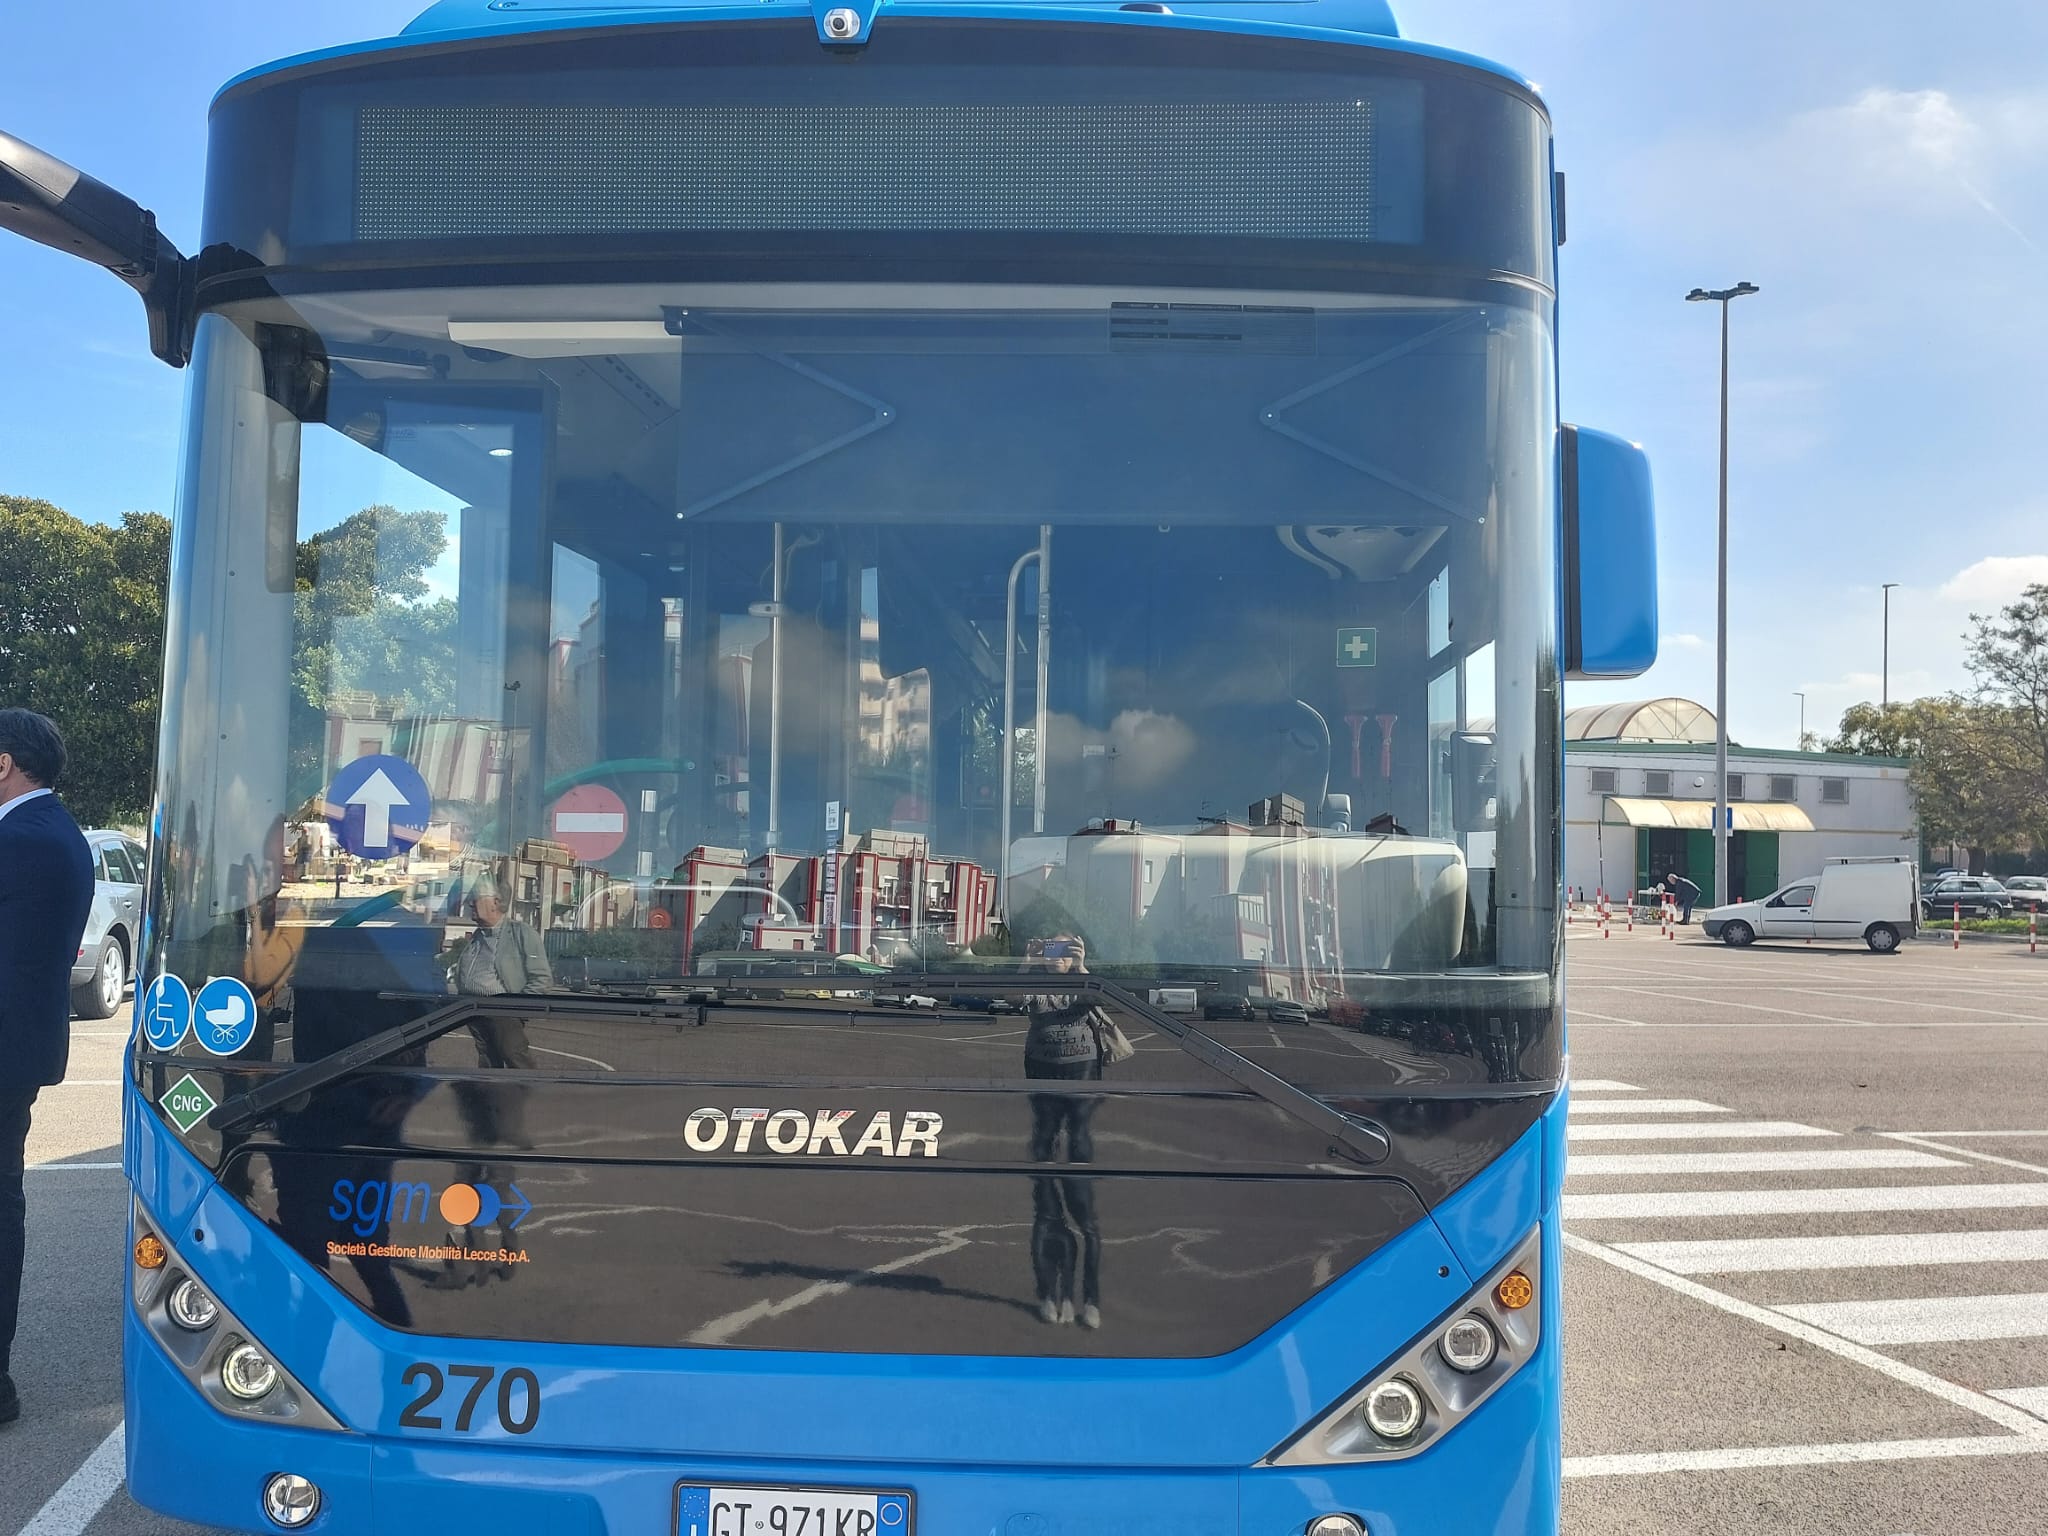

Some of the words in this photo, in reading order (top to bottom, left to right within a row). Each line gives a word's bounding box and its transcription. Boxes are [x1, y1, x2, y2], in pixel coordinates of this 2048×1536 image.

[172, 1094, 202, 1112] CNG
[683, 1107, 944, 1158] OTOKAR
[329, 1179, 431, 1237] sgm
[326, 1241, 366, 1256] Società
[368, 1243, 416, 1258] Gestione
[418, 1245, 462, 1260] Mobilità
[464, 1247, 496, 1261] Lecce
[498, 1248, 530, 1264] S.p.A.
[399, 1362, 540, 1435] 270
